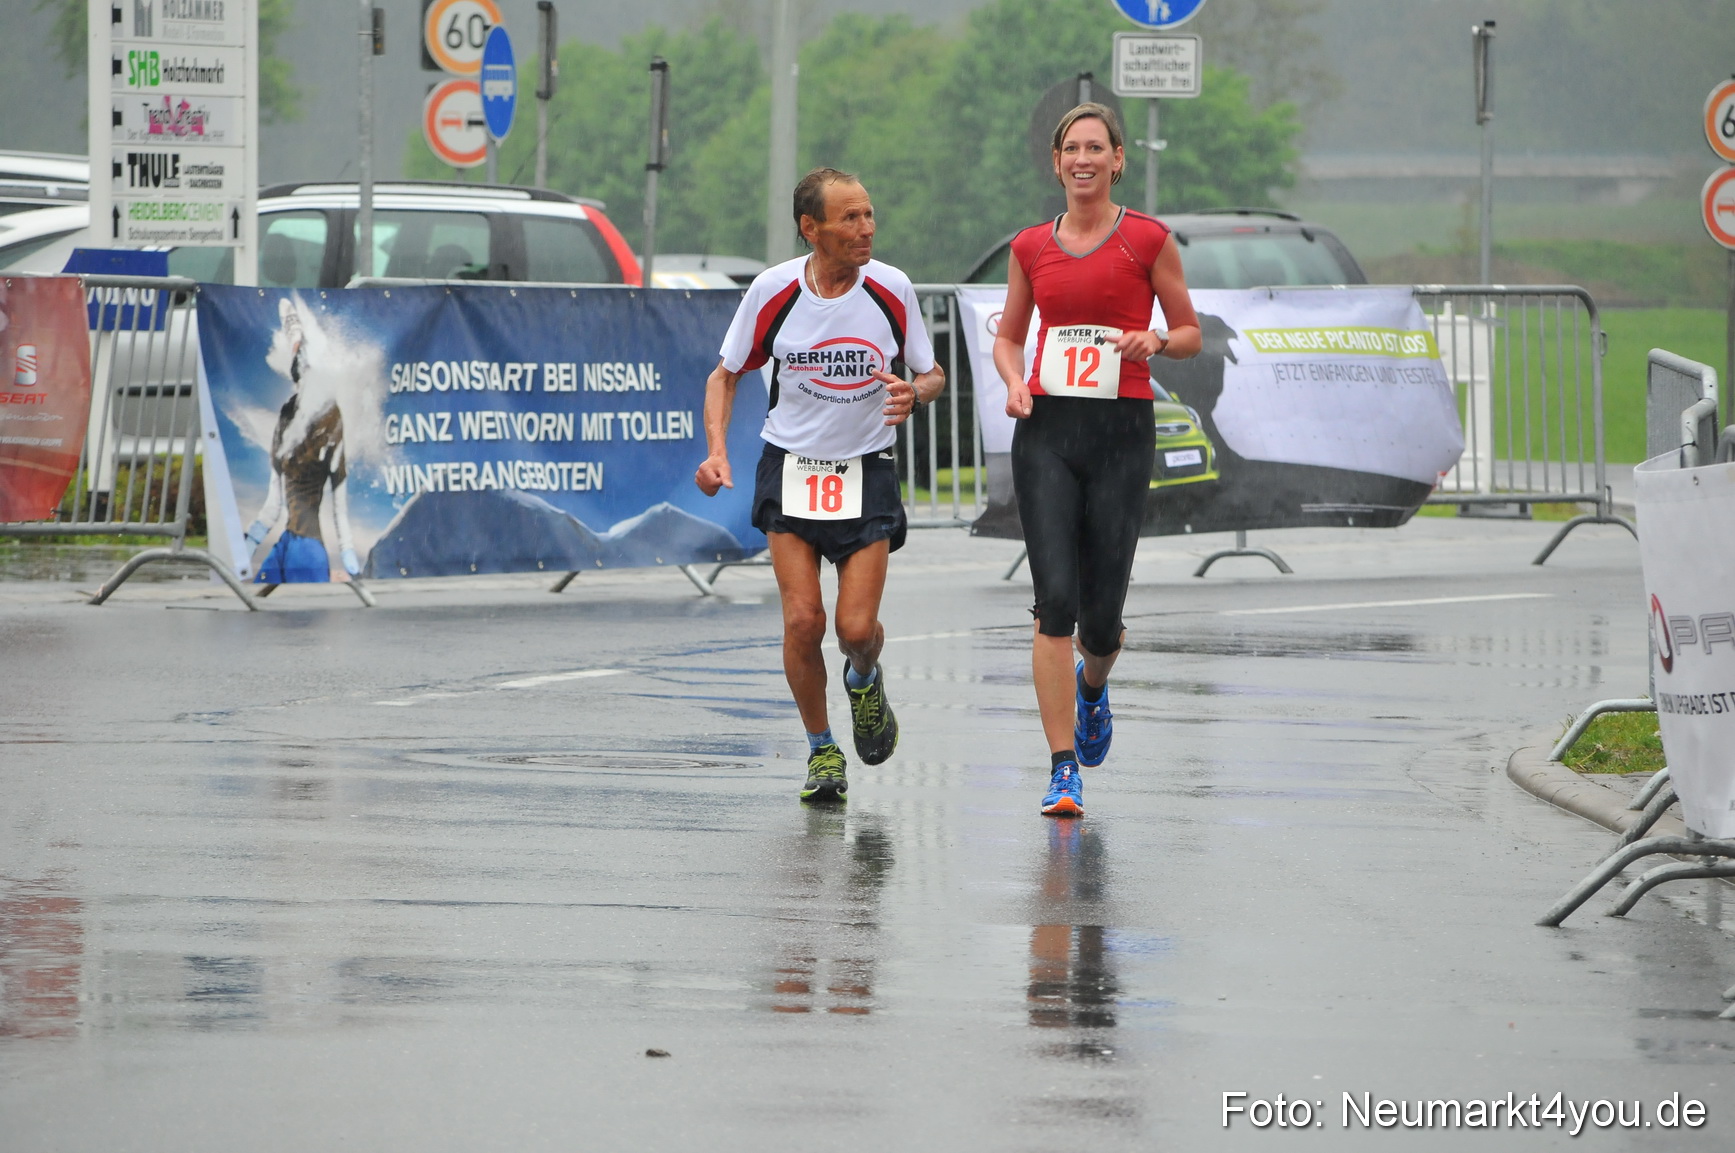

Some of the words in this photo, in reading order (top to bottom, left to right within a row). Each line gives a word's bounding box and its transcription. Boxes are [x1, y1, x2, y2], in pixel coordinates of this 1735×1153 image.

[446, 13, 485, 49] 60
[1128, 41, 1186, 56] Landwirt-
[128, 50, 161, 88] SHB
[162, 56, 225, 83] Holzfachmarkt
[1122, 59, 1191, 72] schaftlicher
[1122, 74, 1167, 88] Verkehr
[1171, 74, 1192, 88] frei
[1721, 103, 1735, 138] 6
[127, 152, 180, 188] THULE
[128, 202, 224, 221] HEIDELBERGCEMENT
[128, 227, 187, 243] Schulungszentrum
[1056, 336, 1092, 344] WERBUNG
[1057, 328, 1092, 337] MEYER
[1251, 332, 1284, 350] DER
[1285, 331, 1327, 350] NEUE
[1327, 330, 1382, 352] PICANTO
[1381, 332, 1398, 353] IST
[1398, 333, 1429, 354] LOS!
[786, 350, 867, 365] GERHART
[869, 354, 875, 362] &
[787, 364, 823, 372] Autohaus
[1063, 346, 1101, 388] 12
[389, 360, 538, 394] SAISONSTART
[543, 362, 577, 392] BEI
[583, 362, 662, 392] NISSAN:
[1271, 363, 1307, 385] JETZT
[1309, 363, 1375, 382] EINFANGEN
[1375, 366, 1396, 385] UND
[1396, 367, 1437, 386] TESTE
[0, 391, 48, 405] SEAT
[797, 382, 812, 396] Das
[813, 391, 851, 405] sportliche
[384, 411, 454, 444] GANZ
[458, 410, 508, 442] WEIT
[509, 412, 574, 442] VORN
[581, 411, 614, 441] MIT
[617, 410, 694, 440] TOLLEN
[796, 456, 833, 466] MEYER
[796, 465, 833, 473] WERBUNG
[383, 460, 604, 494] WINTERANGEBOTEN
[805, 474, 843, 513] 18
[1707, 691, 1730, 714] IST
